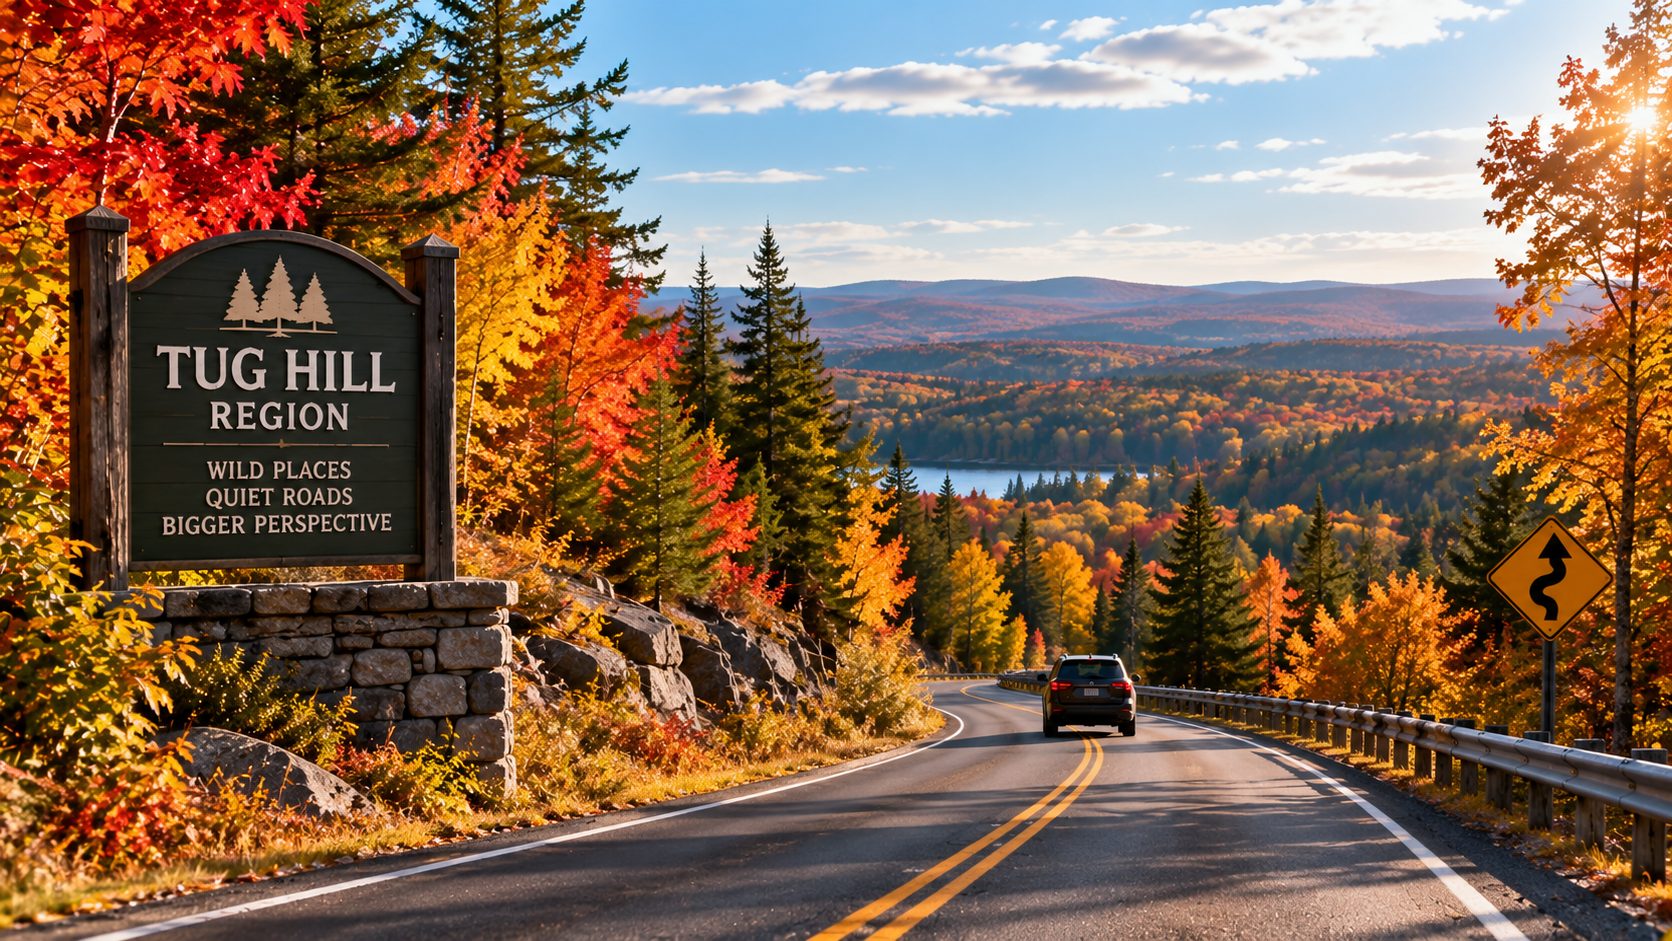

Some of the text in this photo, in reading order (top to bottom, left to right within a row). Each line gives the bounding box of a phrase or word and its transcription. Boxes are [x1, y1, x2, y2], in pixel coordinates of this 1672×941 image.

[157, 345, 396, 392] TUG HILL
[211, 402, 348, 430] REGION
[207, 461, 351, 479] WILD PLACES
[206, 488, 352, 509] QUIET ROADS
[163, 513, 391, 535] BIGGER PERSPECTIVE
